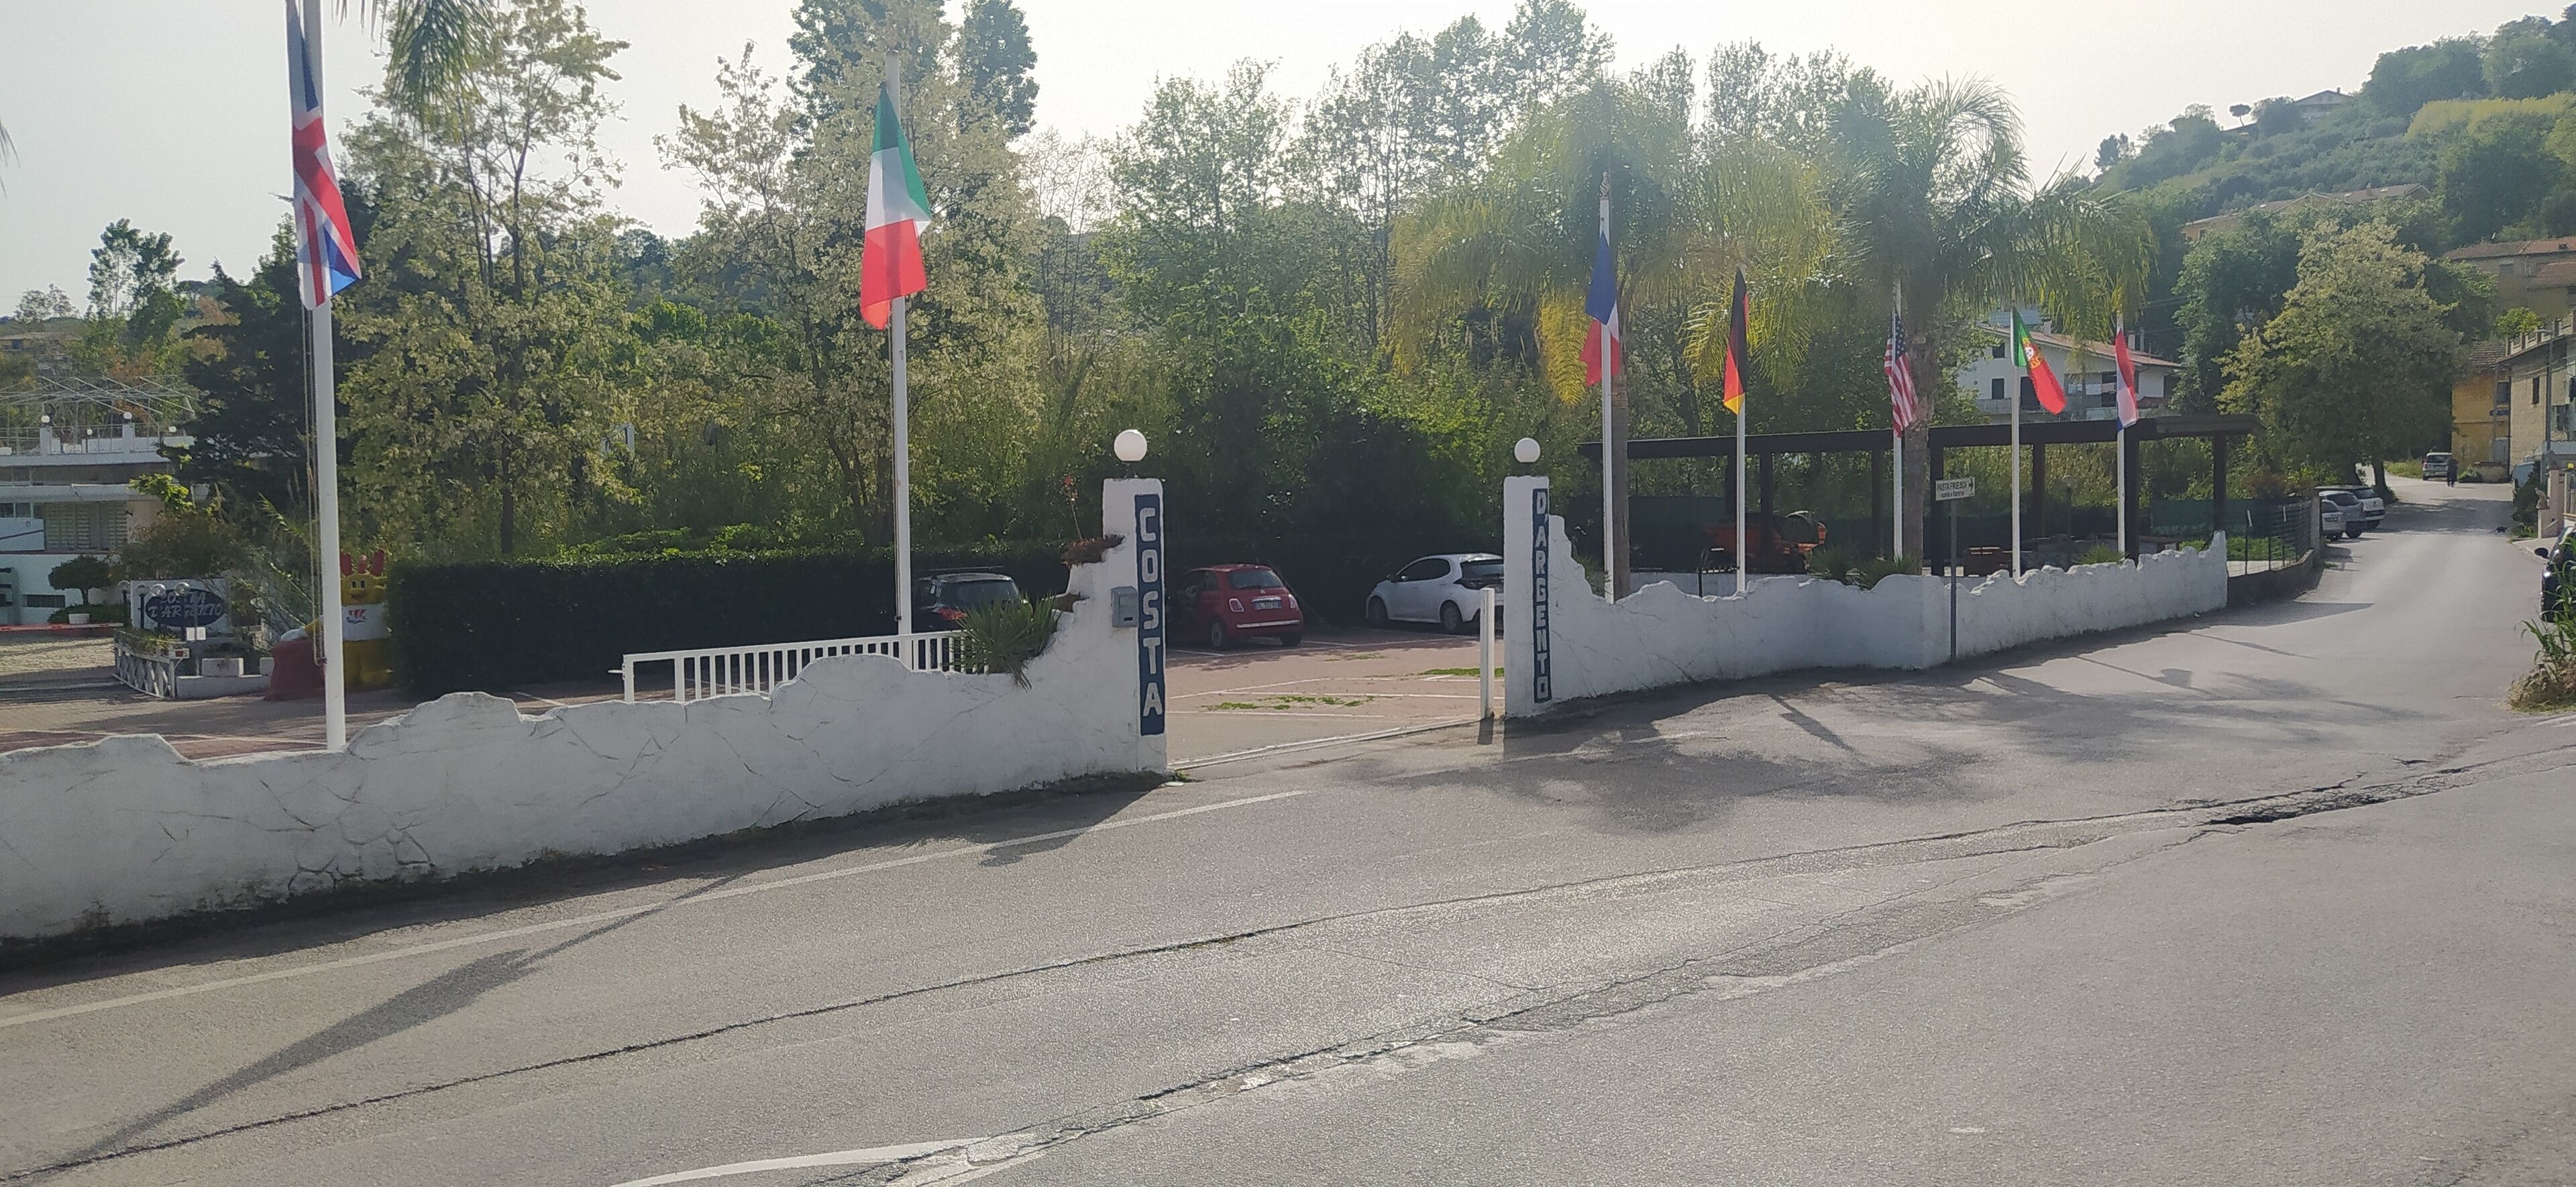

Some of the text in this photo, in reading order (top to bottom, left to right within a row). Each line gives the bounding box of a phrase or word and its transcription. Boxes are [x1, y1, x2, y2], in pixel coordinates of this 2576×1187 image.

[1937, 482, 1949, 492] PASTA
[1140, 507, 1163, 717] COSTA
[1534, 491, 1549, 699] D'ARGENTO
